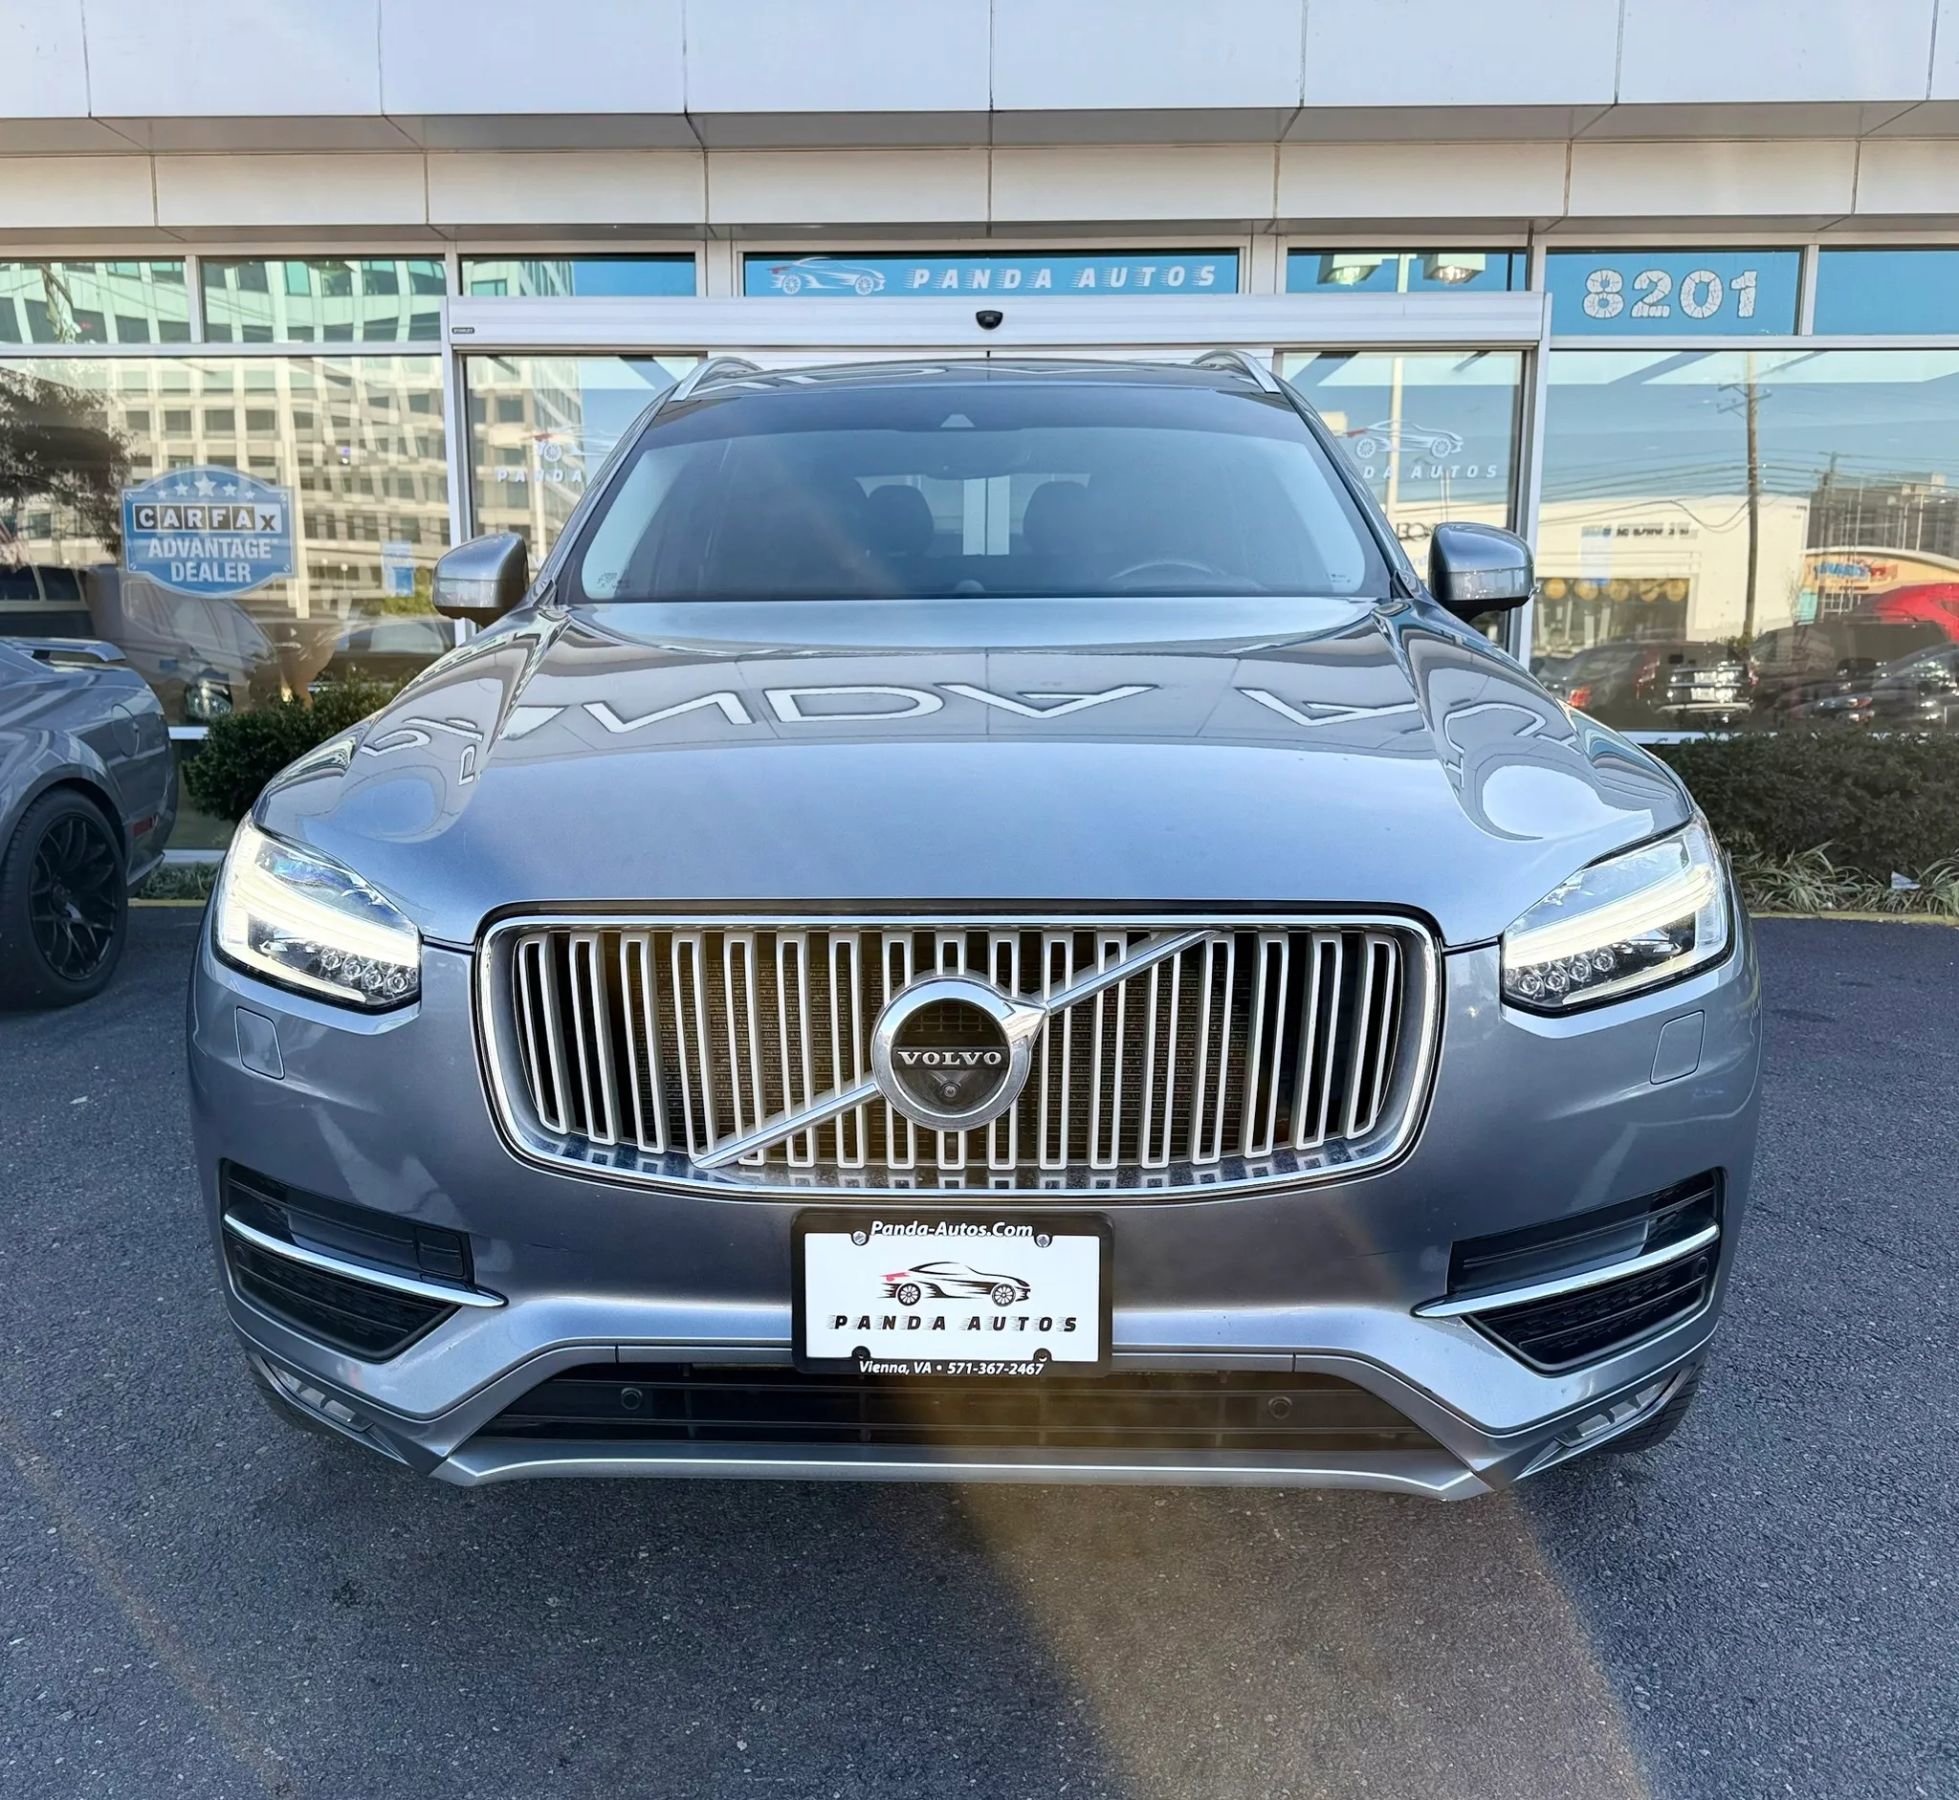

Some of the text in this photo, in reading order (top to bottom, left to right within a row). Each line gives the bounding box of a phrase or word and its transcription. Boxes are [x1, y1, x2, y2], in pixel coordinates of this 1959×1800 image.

[909, 265, 1215, 289] PANDA AUTOS
[1583, 268, 1757, 319] 8201
[1411, 465, 1497, 479] AUTOS
[148, 537, 272, 560] ADVANTAGE
[171, 562, 251, 583] DEALER
[897, 1051, 1002, 1066] VOLVO
[871, 1221, 1033, 1238] Panda-Autos.Com
[833, 1315, 1077, 1332] PANDA AUTOS
[859, 1361, 1044, 1376] Vienna, VA 571-367-2467
